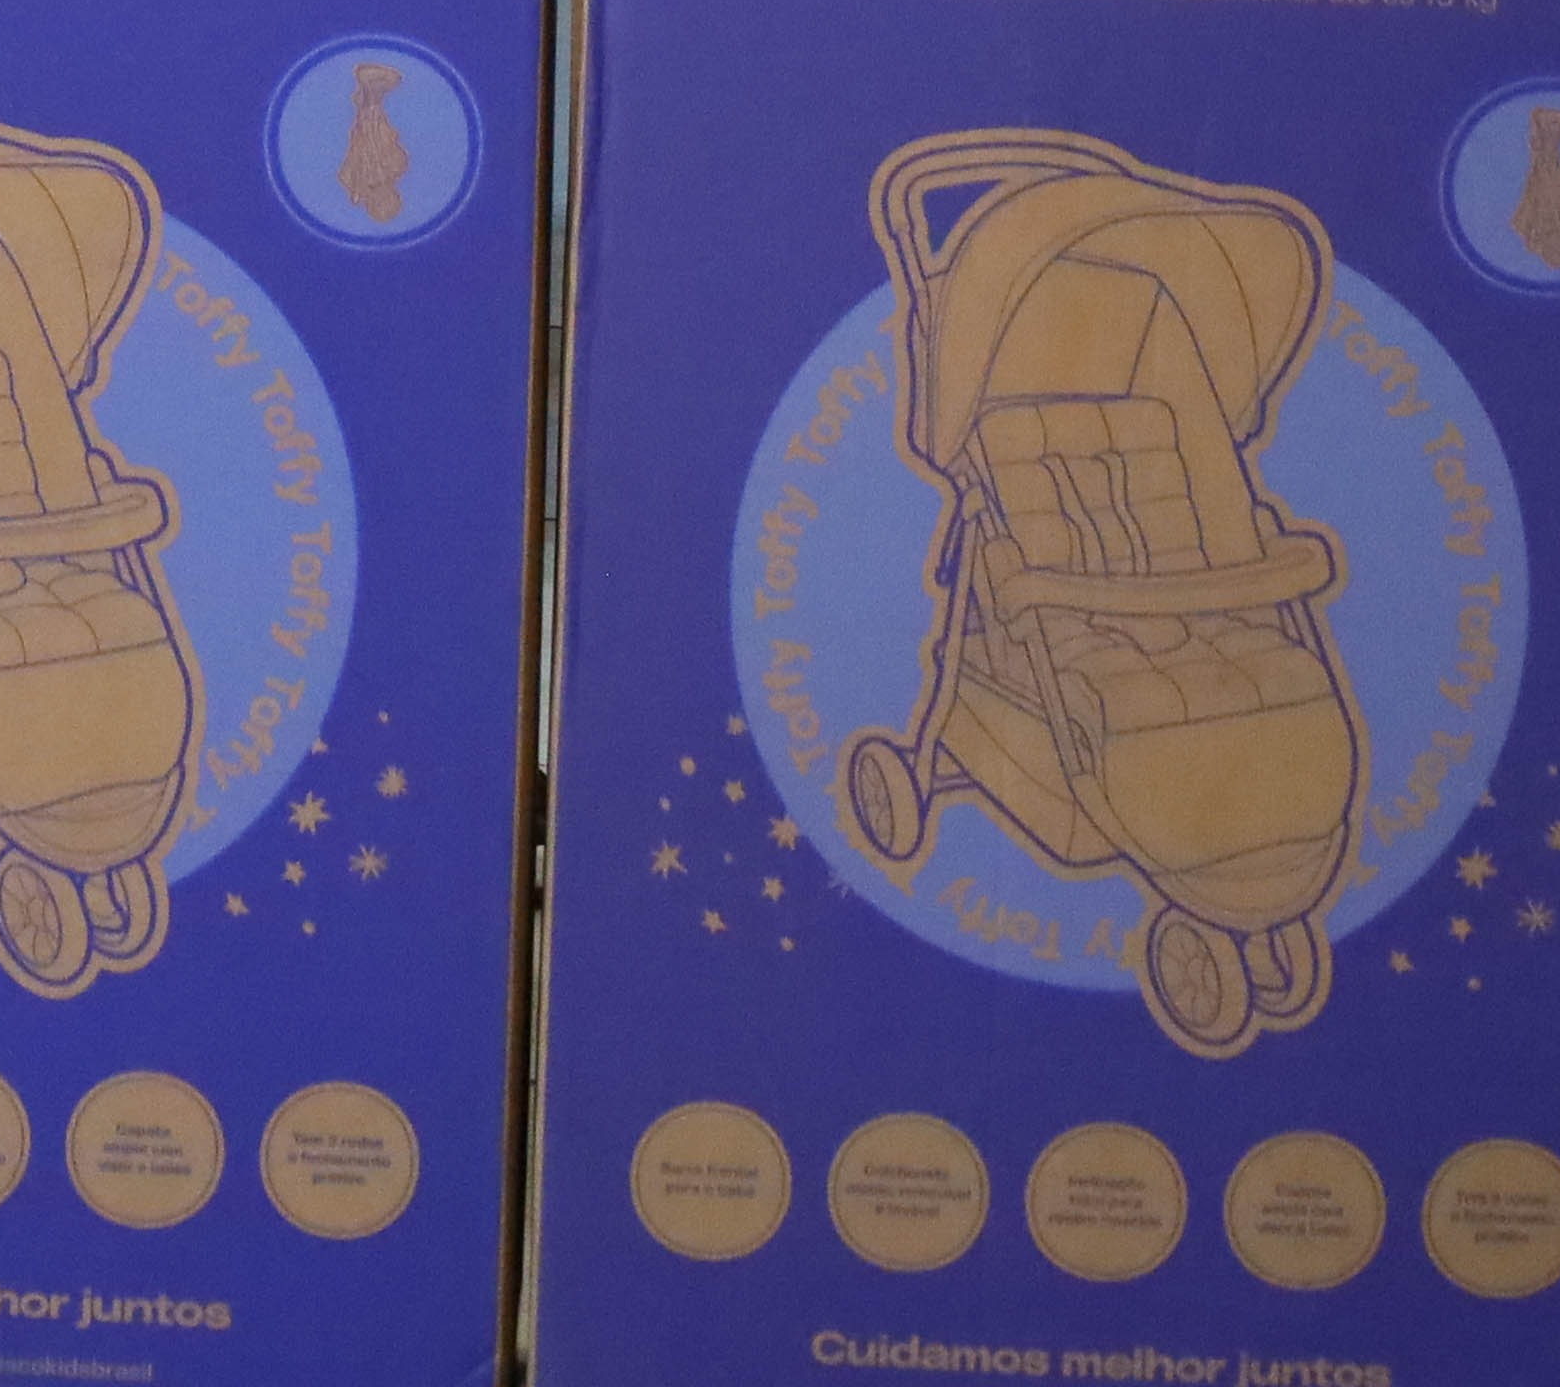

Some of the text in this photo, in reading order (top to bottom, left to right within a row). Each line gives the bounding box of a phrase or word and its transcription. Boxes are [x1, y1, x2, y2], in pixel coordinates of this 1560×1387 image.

[156, 253, 259, 369] Toffy
[1327, 301, 1432, 418] Toffy
[247, 371, 325, 502] Toffy
[785, 346, 890, 465] Toffy
[1423, 422, 1501, 559] Toffy
[269, 521, 334, 663] Toffy
[753, 487, 820, 620] Toffy
[1440, 570, 1505, 710] Toffy
[203, 675, 309, 791] Toffy
[766, 638, 832, 777] Toffy
[76, 1287, 232, 1331] juntos
[812, 1331, 1391, 1387] Cuidamos melhor juntos
